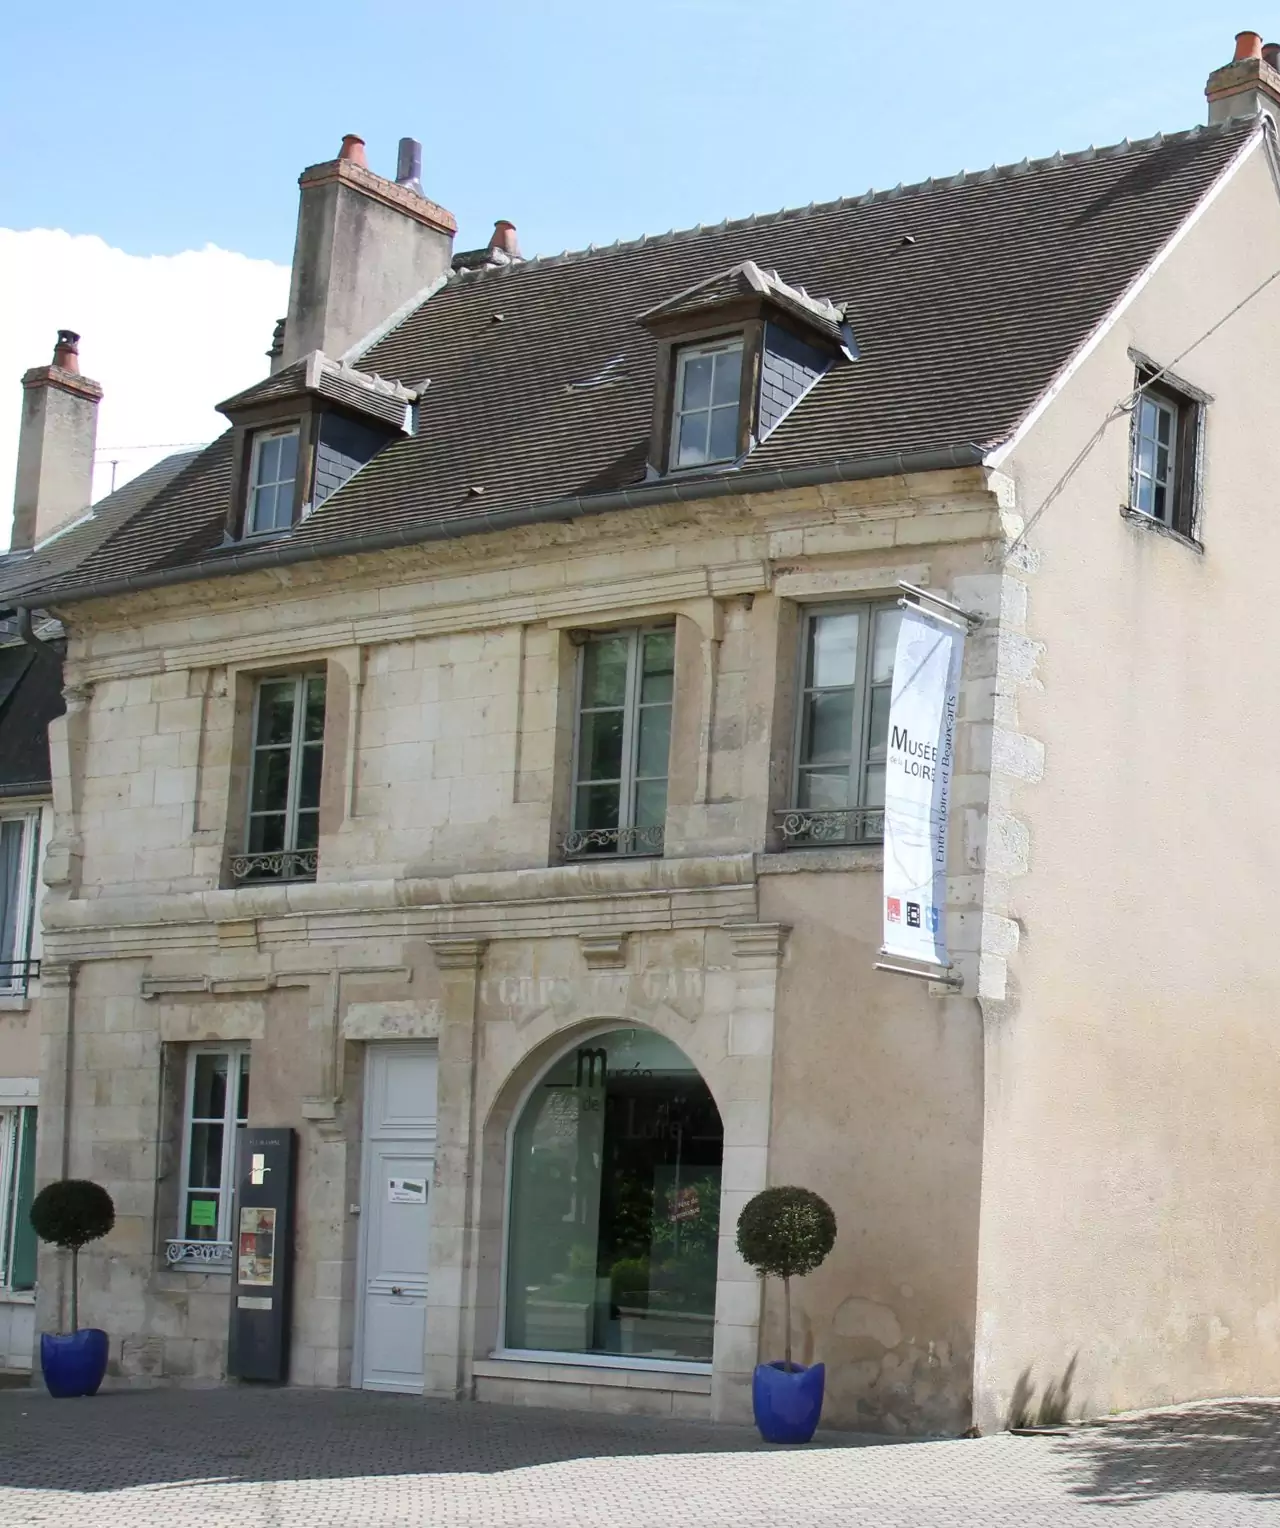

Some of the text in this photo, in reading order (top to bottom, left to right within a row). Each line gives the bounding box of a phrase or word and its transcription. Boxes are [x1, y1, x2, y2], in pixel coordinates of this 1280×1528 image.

[891, 725, 937, 762] MUSÉE
[904, 759, 936, 783] LOIRE
[936, 694, 956, 864] Entre Loire et Beaux-arts
